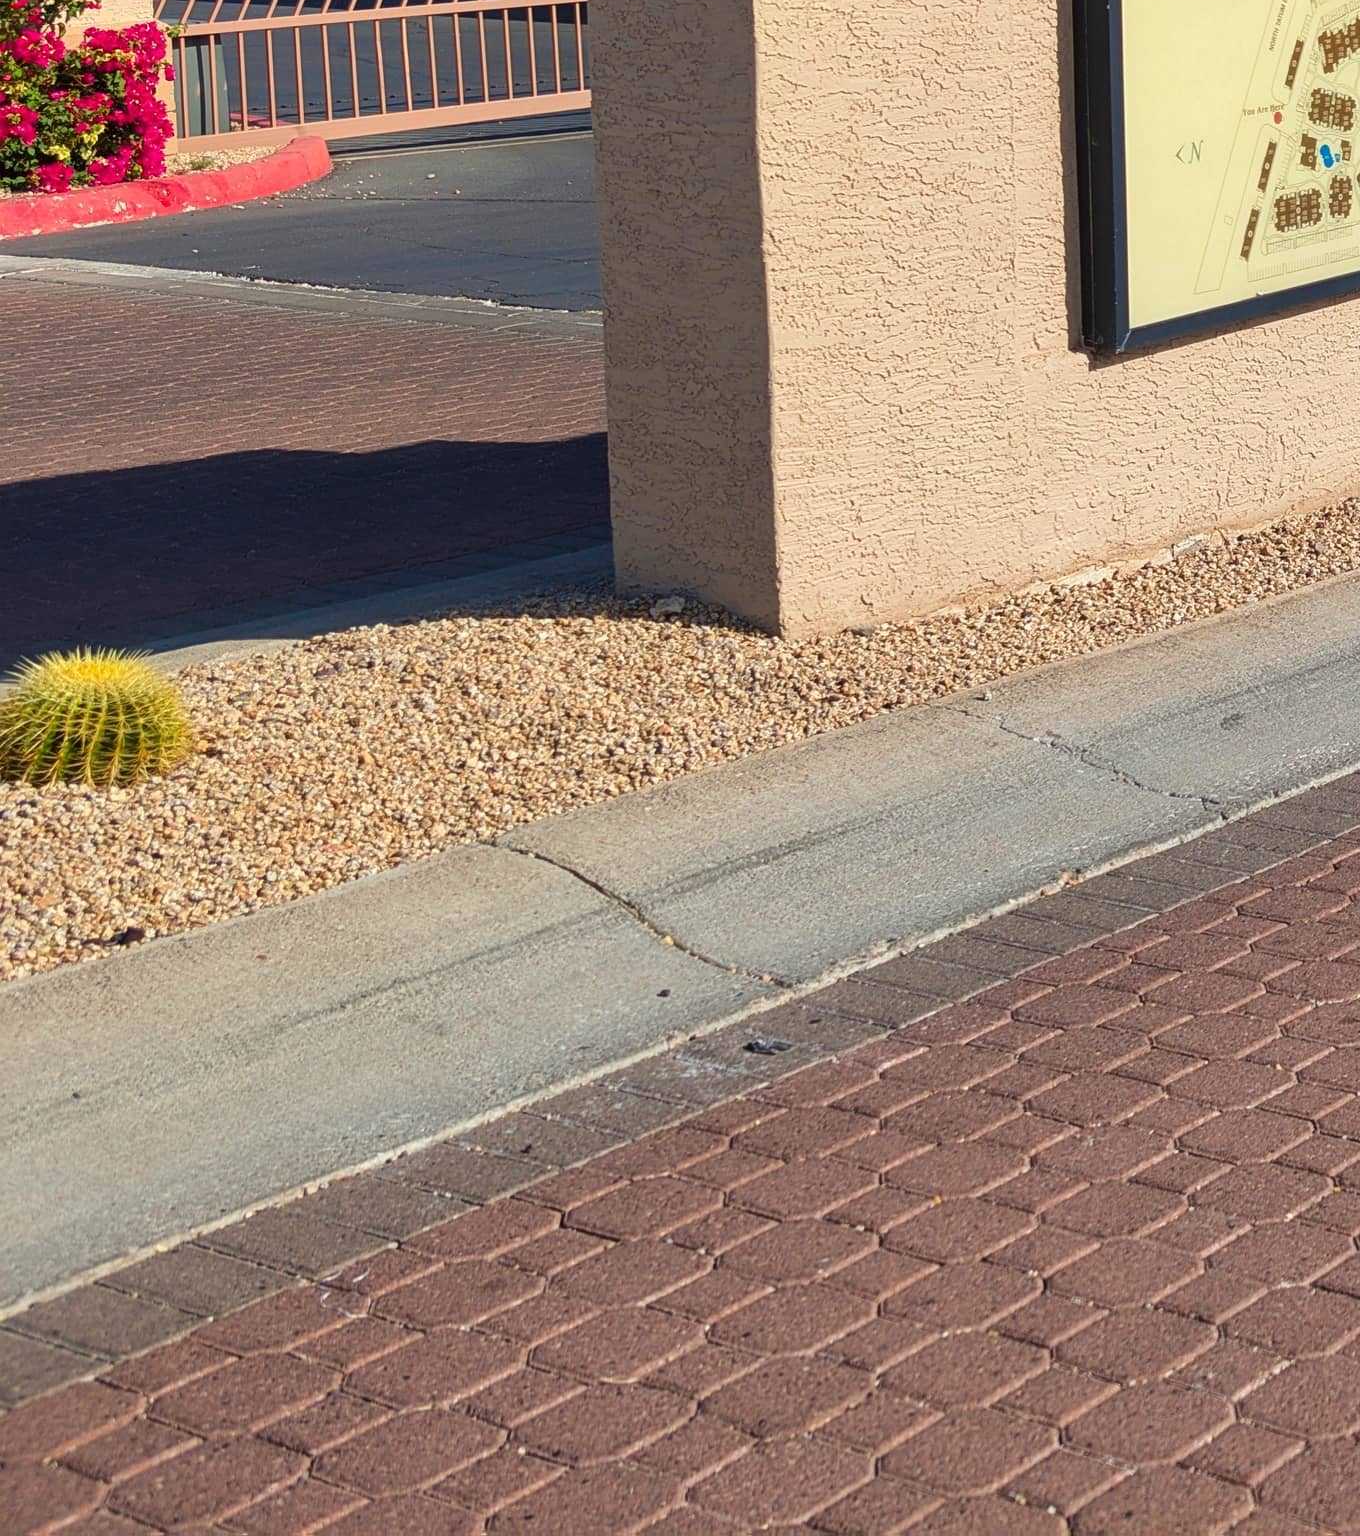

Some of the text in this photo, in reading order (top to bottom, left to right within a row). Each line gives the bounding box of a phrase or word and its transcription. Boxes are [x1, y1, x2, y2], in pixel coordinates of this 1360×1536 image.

[1268, 25, 1281, 52] NORTH
[1242, 103, 1285, 117] You Are Here
[1188, 139, 1204, 164] N
